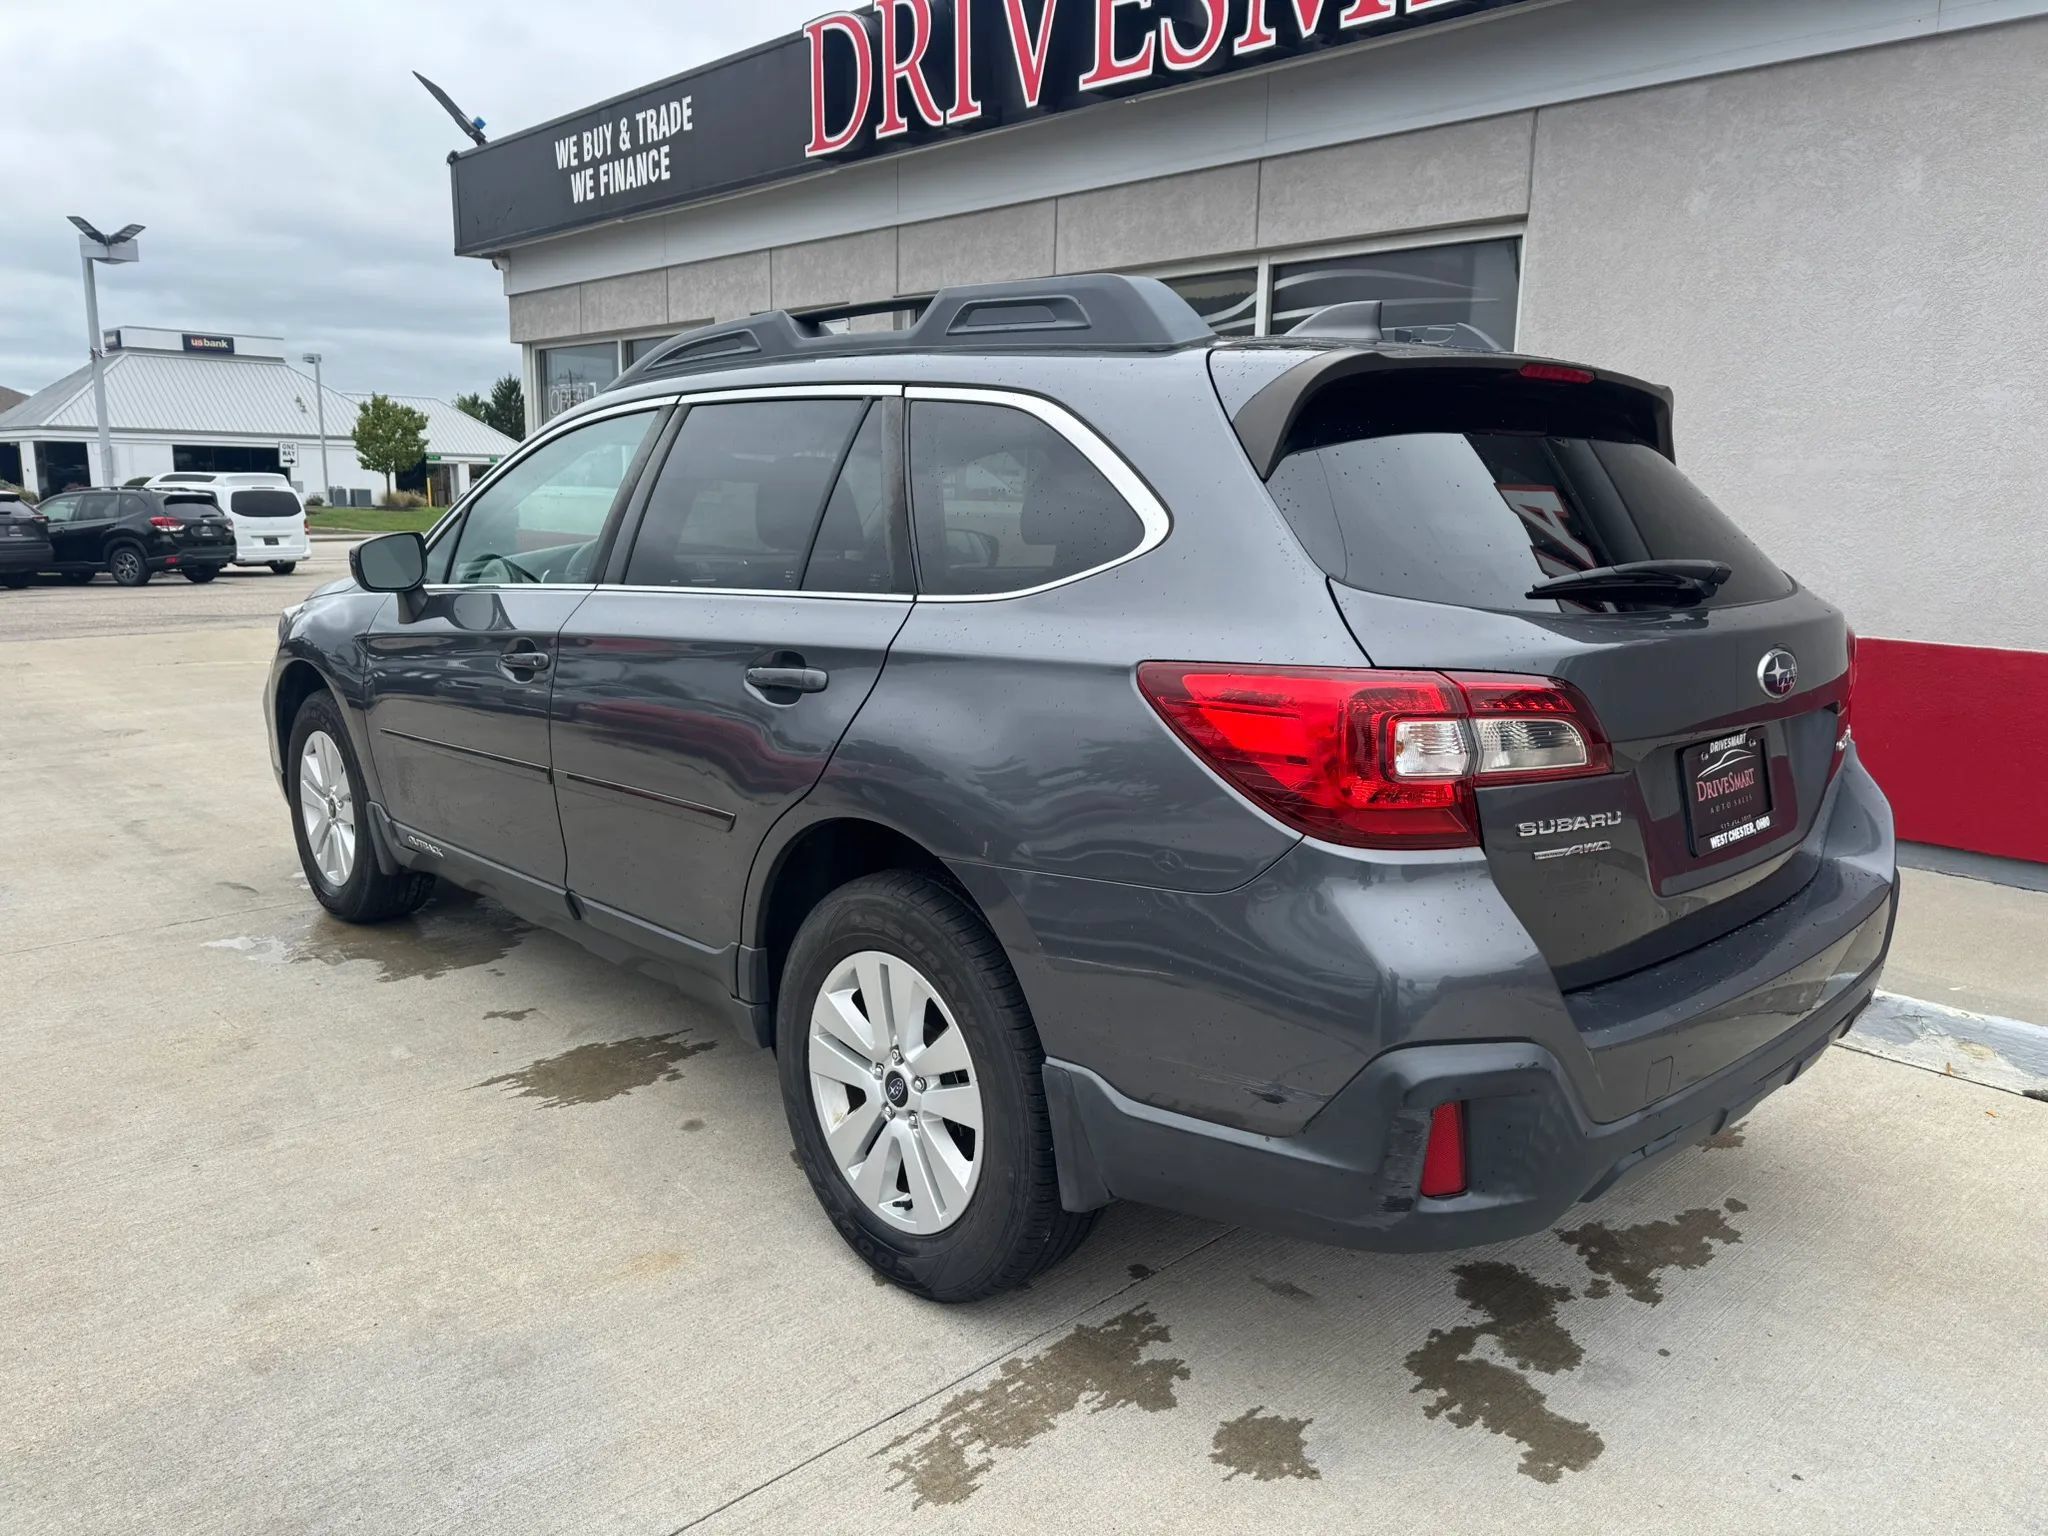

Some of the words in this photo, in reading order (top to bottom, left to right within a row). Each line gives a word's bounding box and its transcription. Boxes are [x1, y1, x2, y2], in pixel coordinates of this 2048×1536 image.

[803, 0, 1467, 157] DRIVE
[554, 134, 579, 170] WE
[583, 122, 613, 163] BUY
[618, 117, 632, 152] &
[635, 95, 693, 145] TRADE
[570, 167, 595, 204] WE
[599, 145, 671, 197] FINANCE
[1709, 732, 1747, 754] DRIVESMART
[1517, 810, 1622, 837] SUBARU
[1710, 803, 1732, 815] AUTO
[1709, 832, 1729, 849] WEST
[1728, 821, 1757, 843] CHESTER,
[1755, 815, 1771, 831] OHIO
[1565, 840, 1612, 857] AWD
